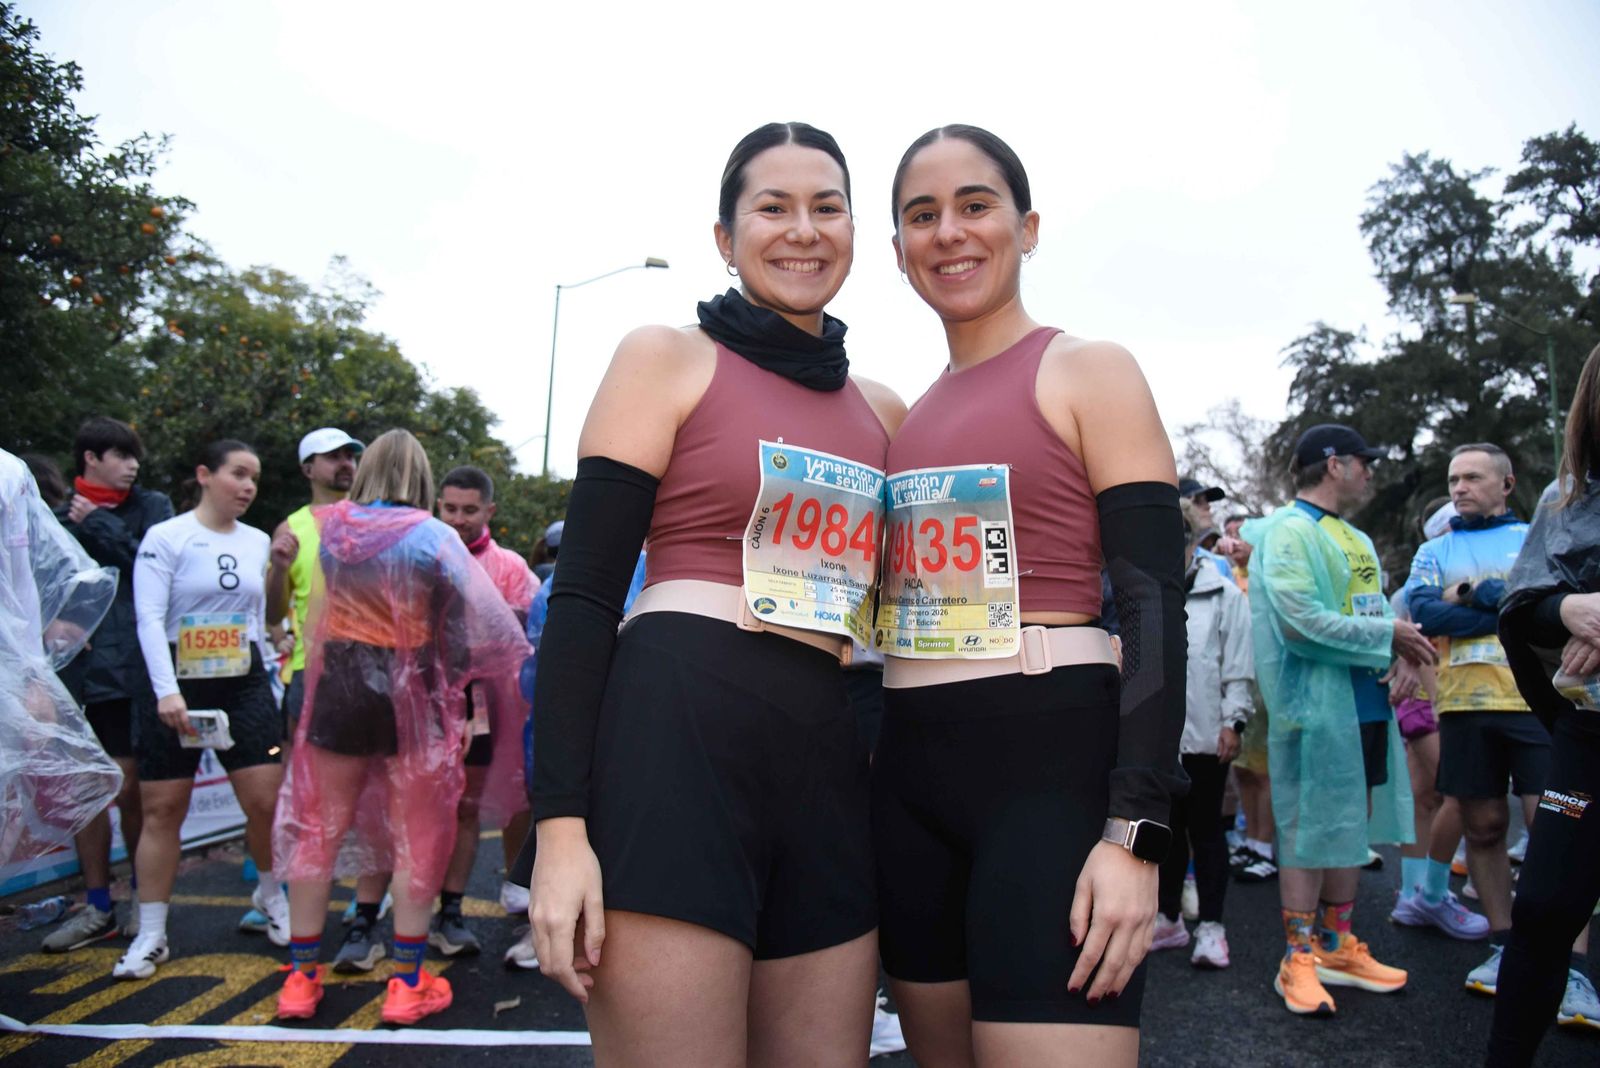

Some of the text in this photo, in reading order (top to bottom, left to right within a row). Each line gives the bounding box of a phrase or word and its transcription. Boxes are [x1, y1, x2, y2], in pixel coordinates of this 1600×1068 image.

[836, 475, 875, 496] sevilla
[752, 516, 767, 550] CAJÓN
[772, 492, 886, 562] 1984
[773, 565, 799, 577] Ixone
[820, 558, 847, 573] Ixone
[921, 596, 968, 606] Carretero
[814, 610, 842, 623] HOKA
[931, 608, 949, 616] 2026
[183, 629, 241, 650] 15295
[896, 637, 912, 648] HOKA
[917, 640, 951, 649] Sprinter
[1544, 789, 1588, 808] VENICE
